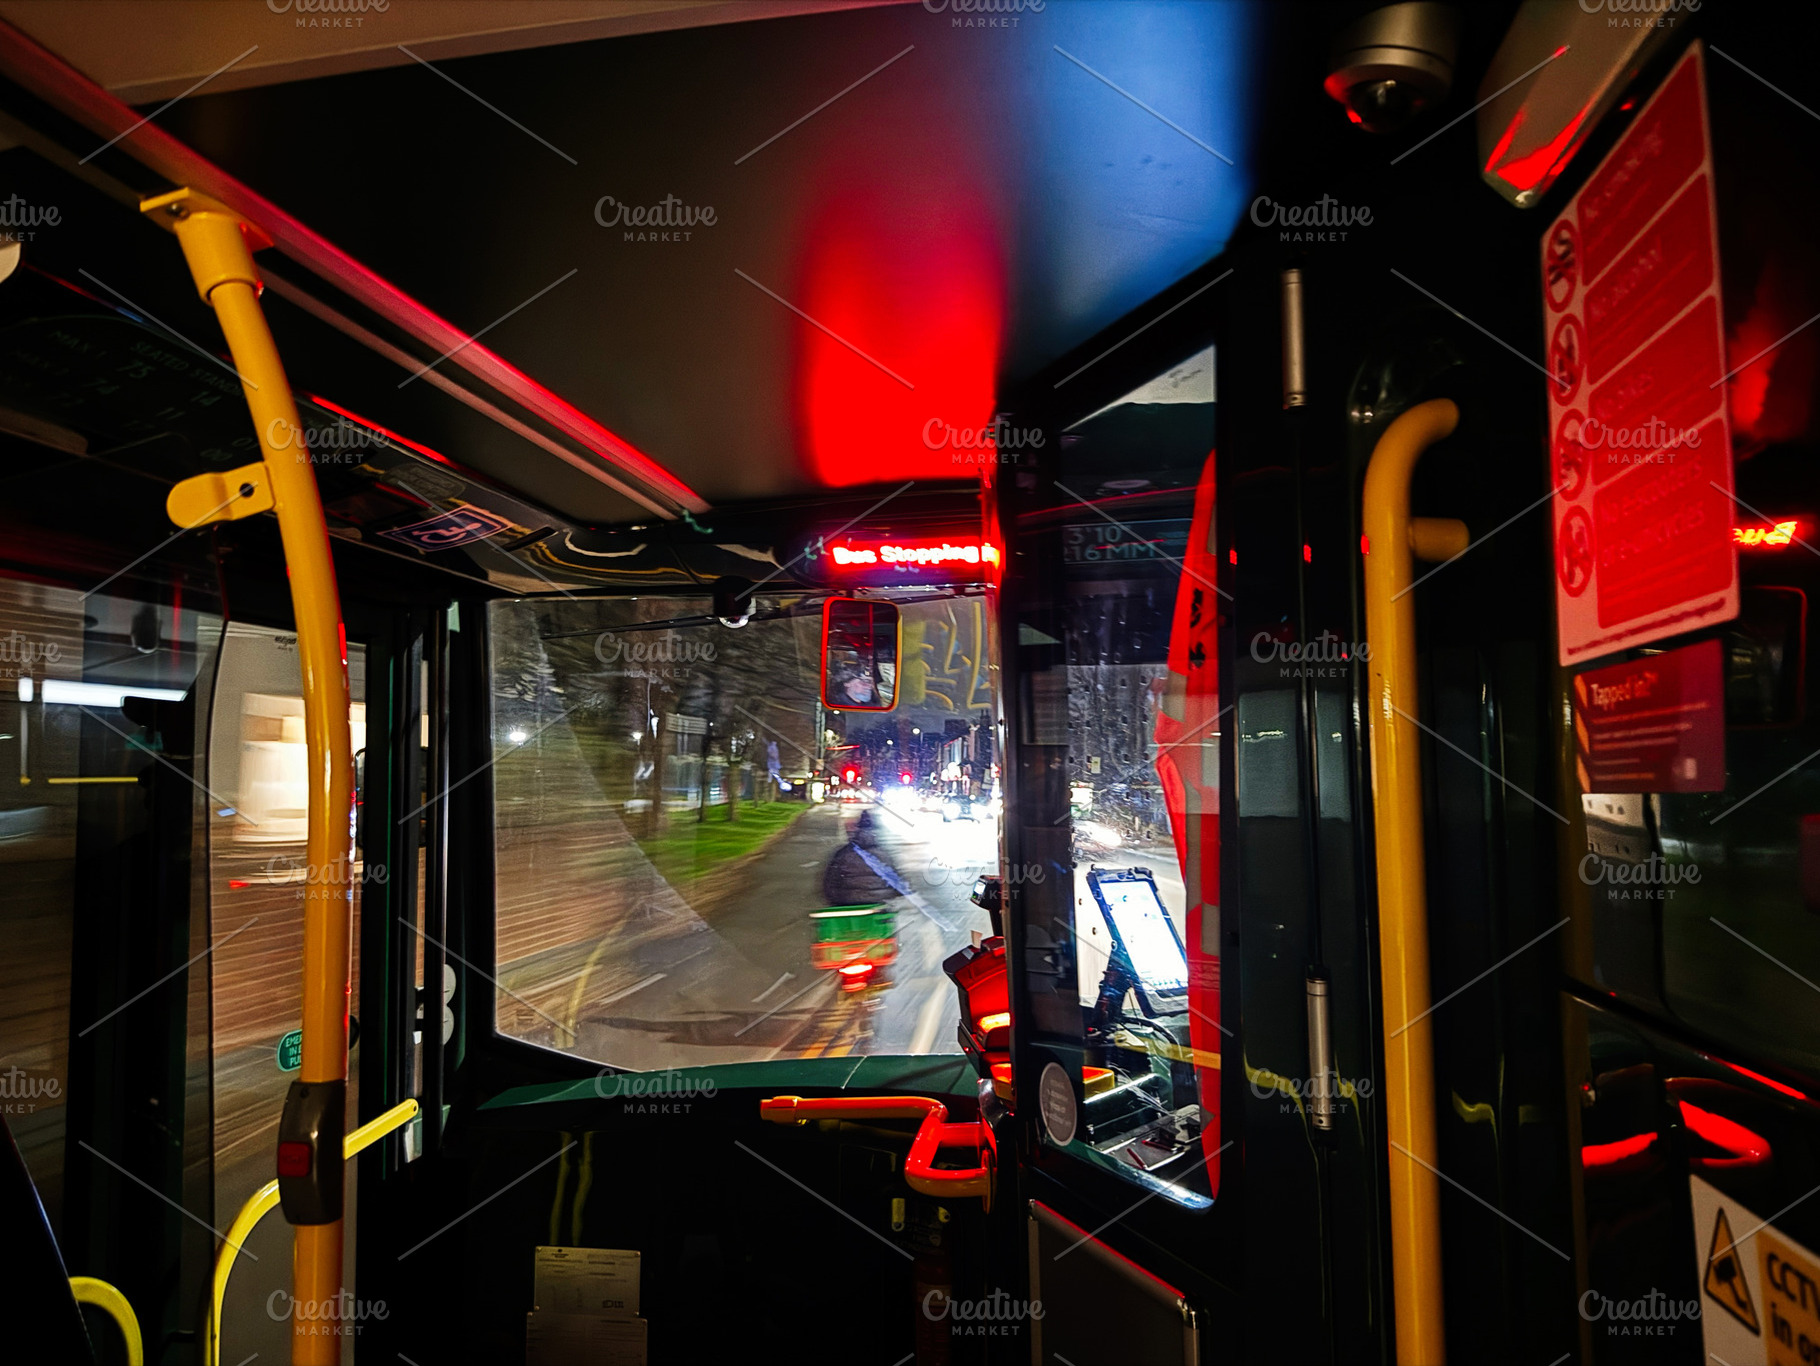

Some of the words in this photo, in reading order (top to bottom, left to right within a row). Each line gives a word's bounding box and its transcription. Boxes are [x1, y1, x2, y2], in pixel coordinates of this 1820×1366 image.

[130, 341, 189, 372] SEATED
[832, 546, 878, 565] Bus
[879, 543, 980, 565] Stopping
[286, 1034, 302, 1047] EME
[1771, 1300, 1793, 1350] in
